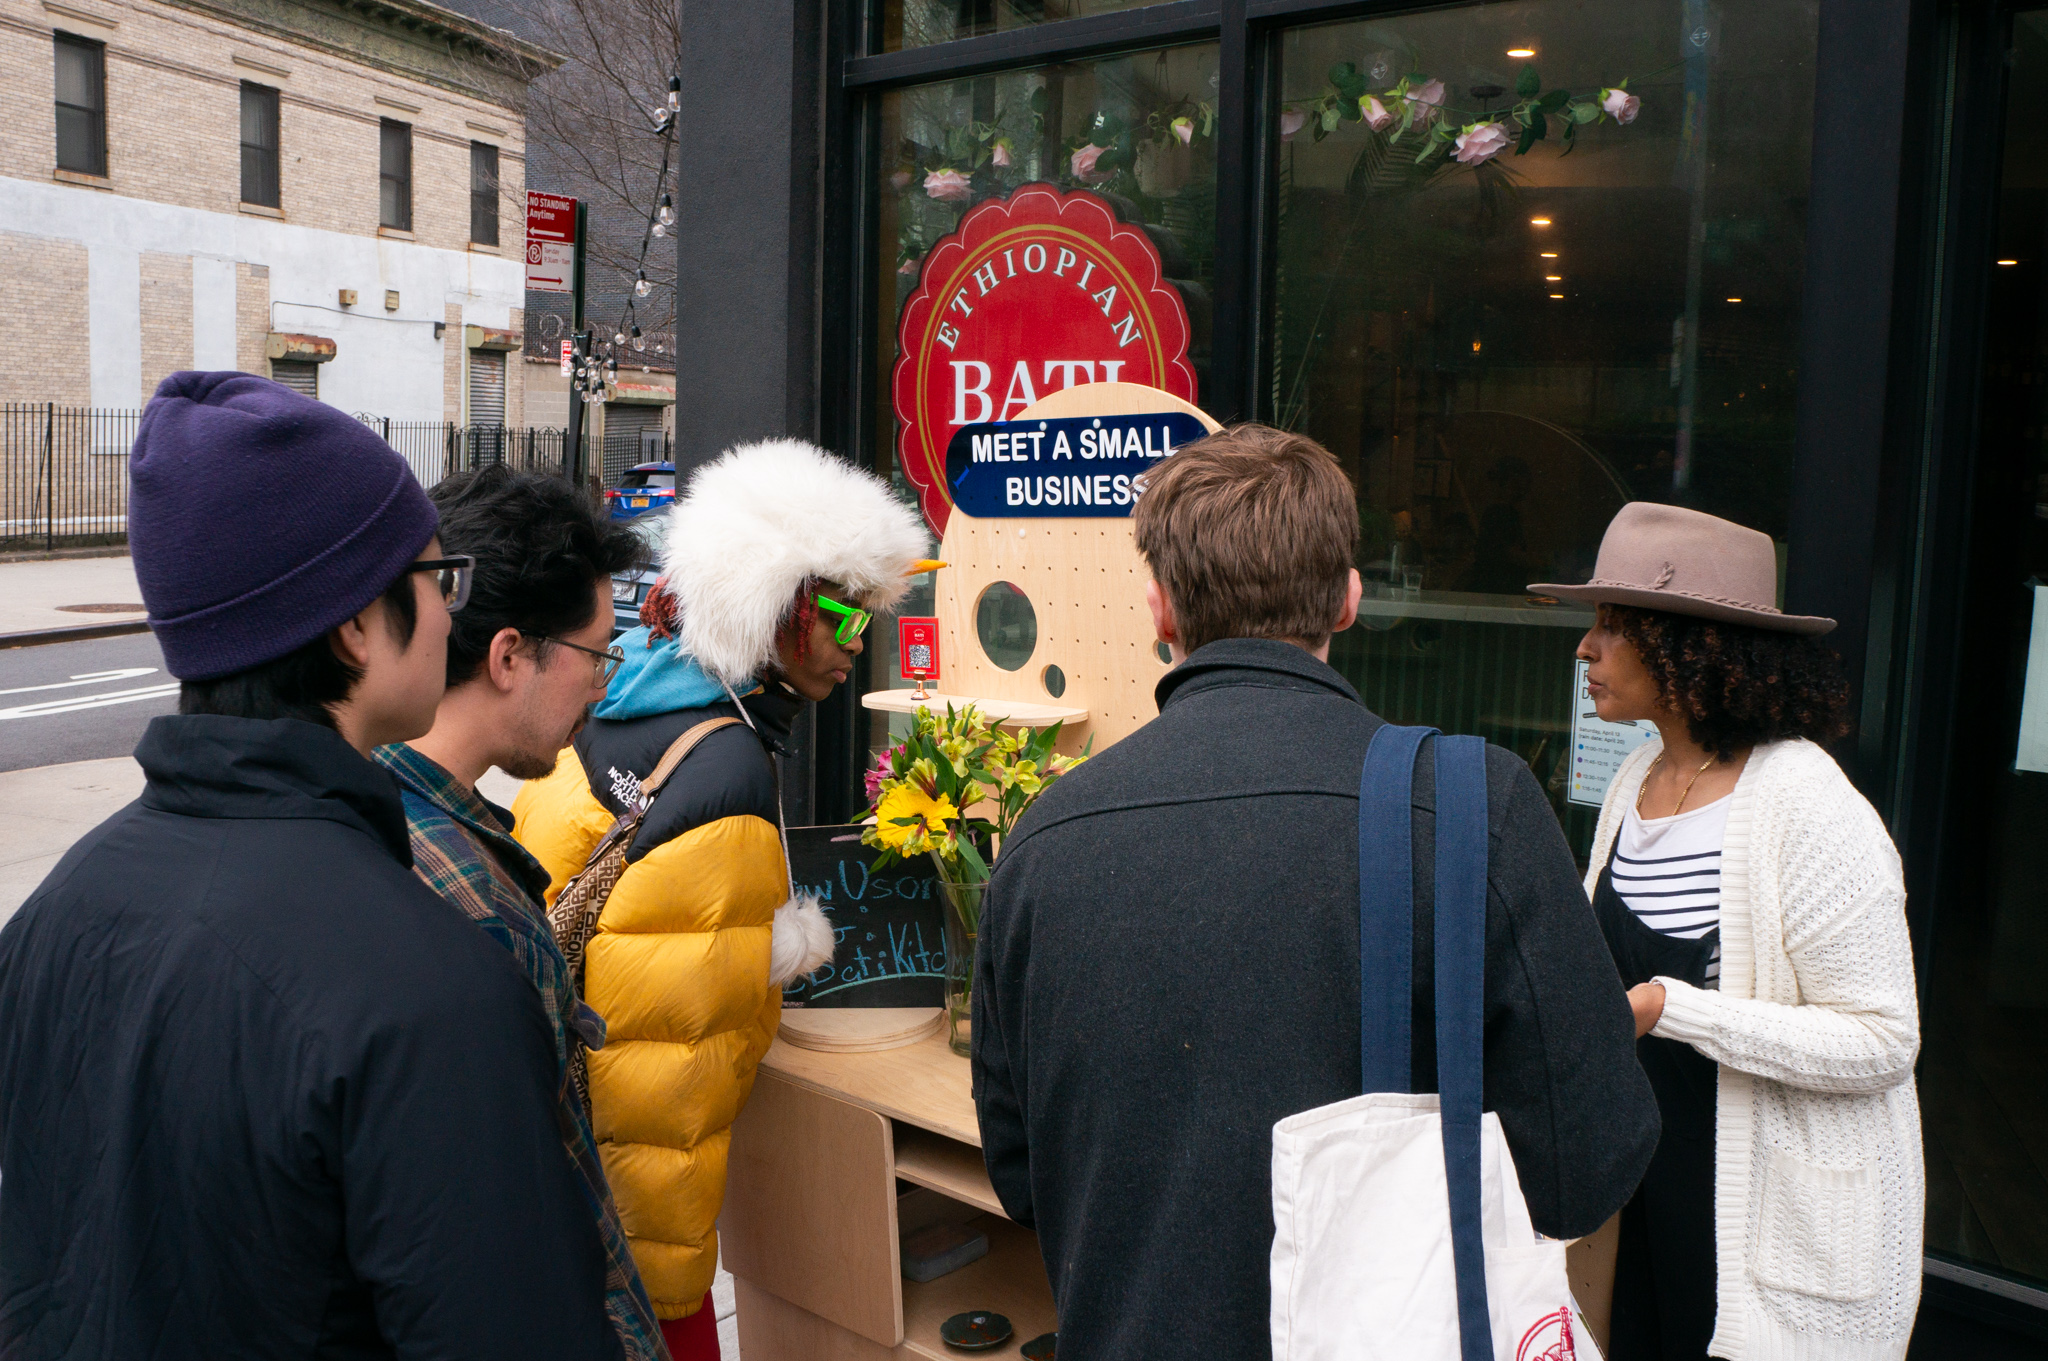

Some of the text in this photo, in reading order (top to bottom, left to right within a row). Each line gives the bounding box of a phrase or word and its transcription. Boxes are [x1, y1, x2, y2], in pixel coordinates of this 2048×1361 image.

[530, 196, 570, 211] NO STANDING
[530, 208, 555, 220] Anytime
[936, 243, 1142, 353] ETHIOPIAN
[972, 426, 1179, 463] MEET A SMALL
[610, 783, 634, 808] FACE
